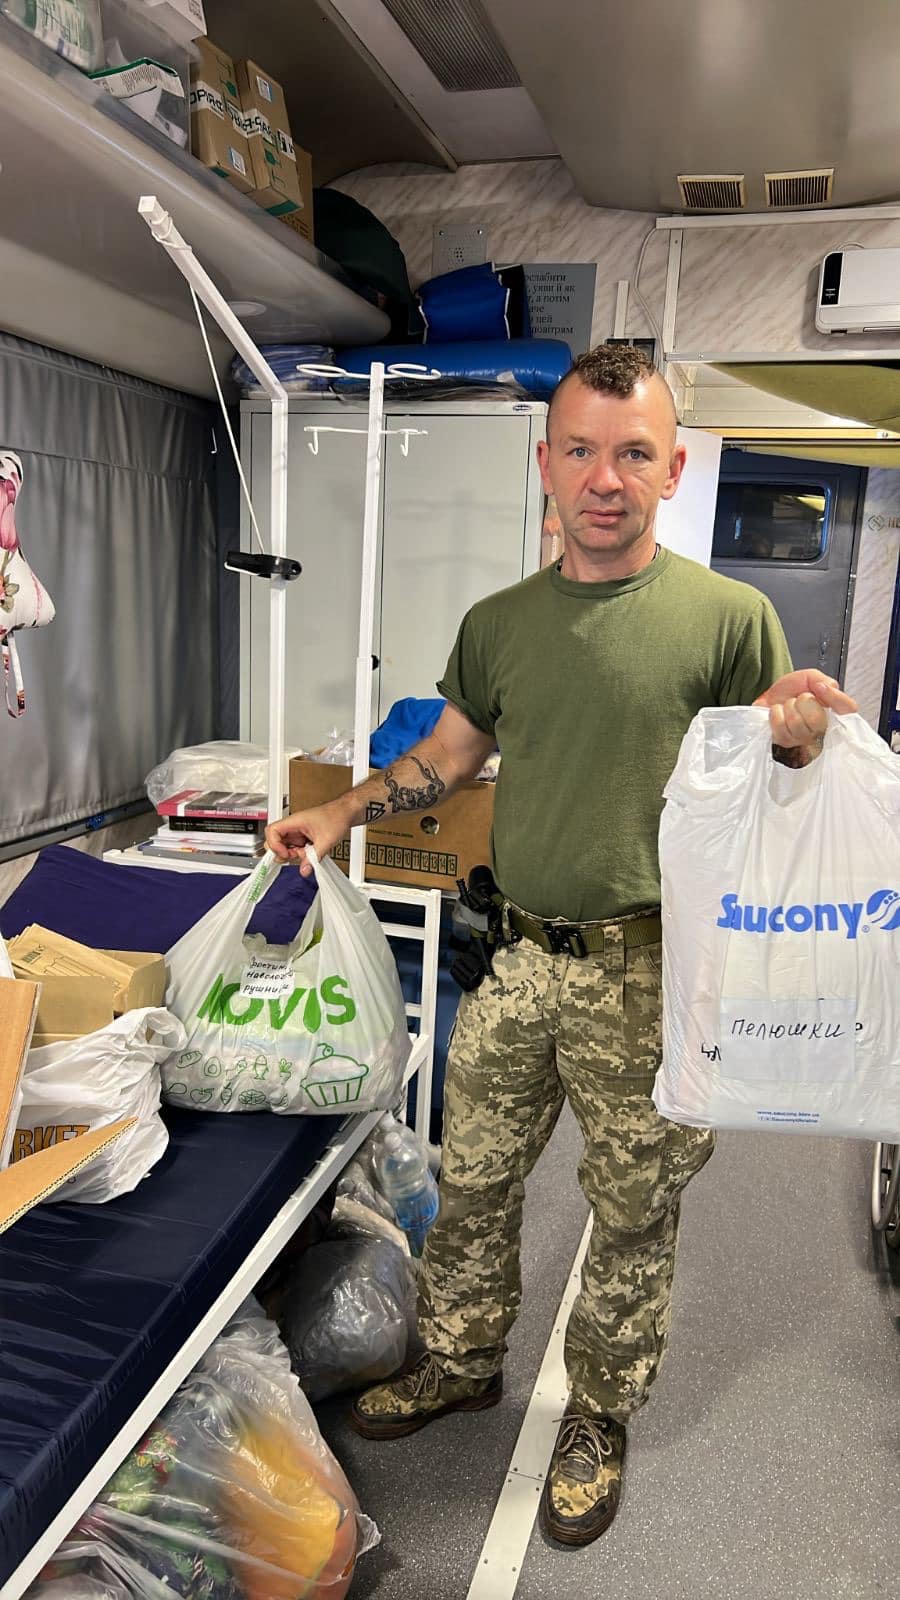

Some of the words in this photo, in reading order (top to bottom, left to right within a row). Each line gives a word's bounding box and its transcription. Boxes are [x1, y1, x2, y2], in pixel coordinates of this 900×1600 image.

[525, 272, 567, 281] ослабити
[370, 846, 376, 860] 6
[378, 848, 384, 862] 7
[387, 848, 393, 863] 8
[395, 848, 401, 864] 9
[404, 850, 411, 867] 10
[413, 851, 420, 868] 11
[421, 852, 429, 869] 12
[430, 853, 438, 871] 13
[439, 854, 446, 872] 14
[448, 856, 456, 873] 15
[716, 893, 863, 939] Saucony
[9, 1124, 91, 1164] RKET
